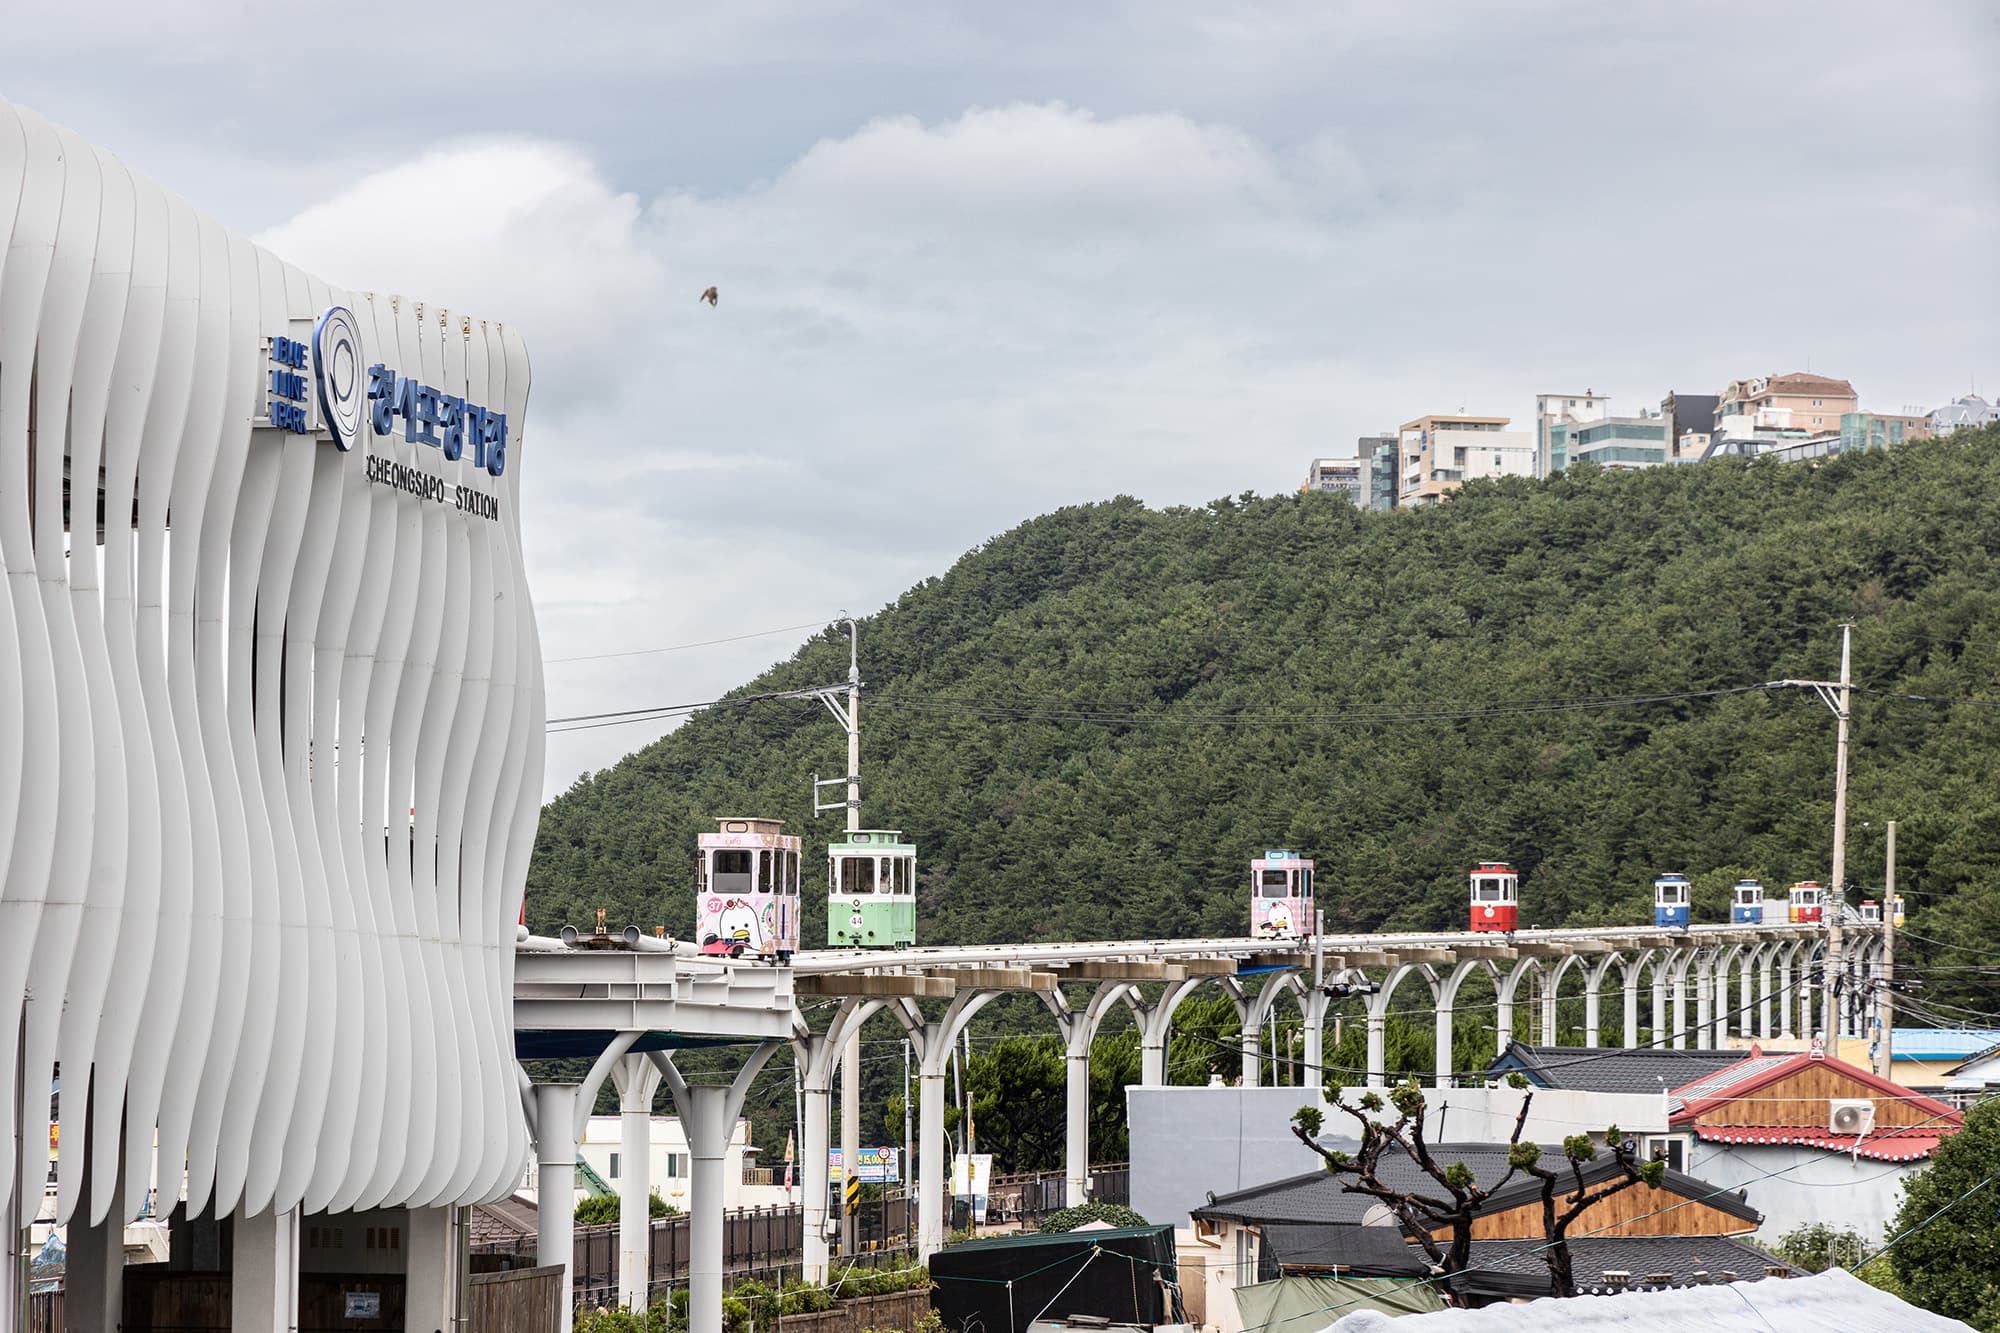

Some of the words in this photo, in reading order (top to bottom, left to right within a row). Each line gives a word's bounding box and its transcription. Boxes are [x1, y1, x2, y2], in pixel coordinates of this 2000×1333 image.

[271, 336, 308, 370] BLUE
[271, 369, 308, 403] LINE
[271, 401, 307, 435] PARK
[368, 363, 508, 477] 청사포정거장
[367, 455, 445, 503] CHEONGSAPO
[455, 485, 498, 521] STATION
[708, 903, 720, 912] 37
[851, 916, 862, 925] 44
